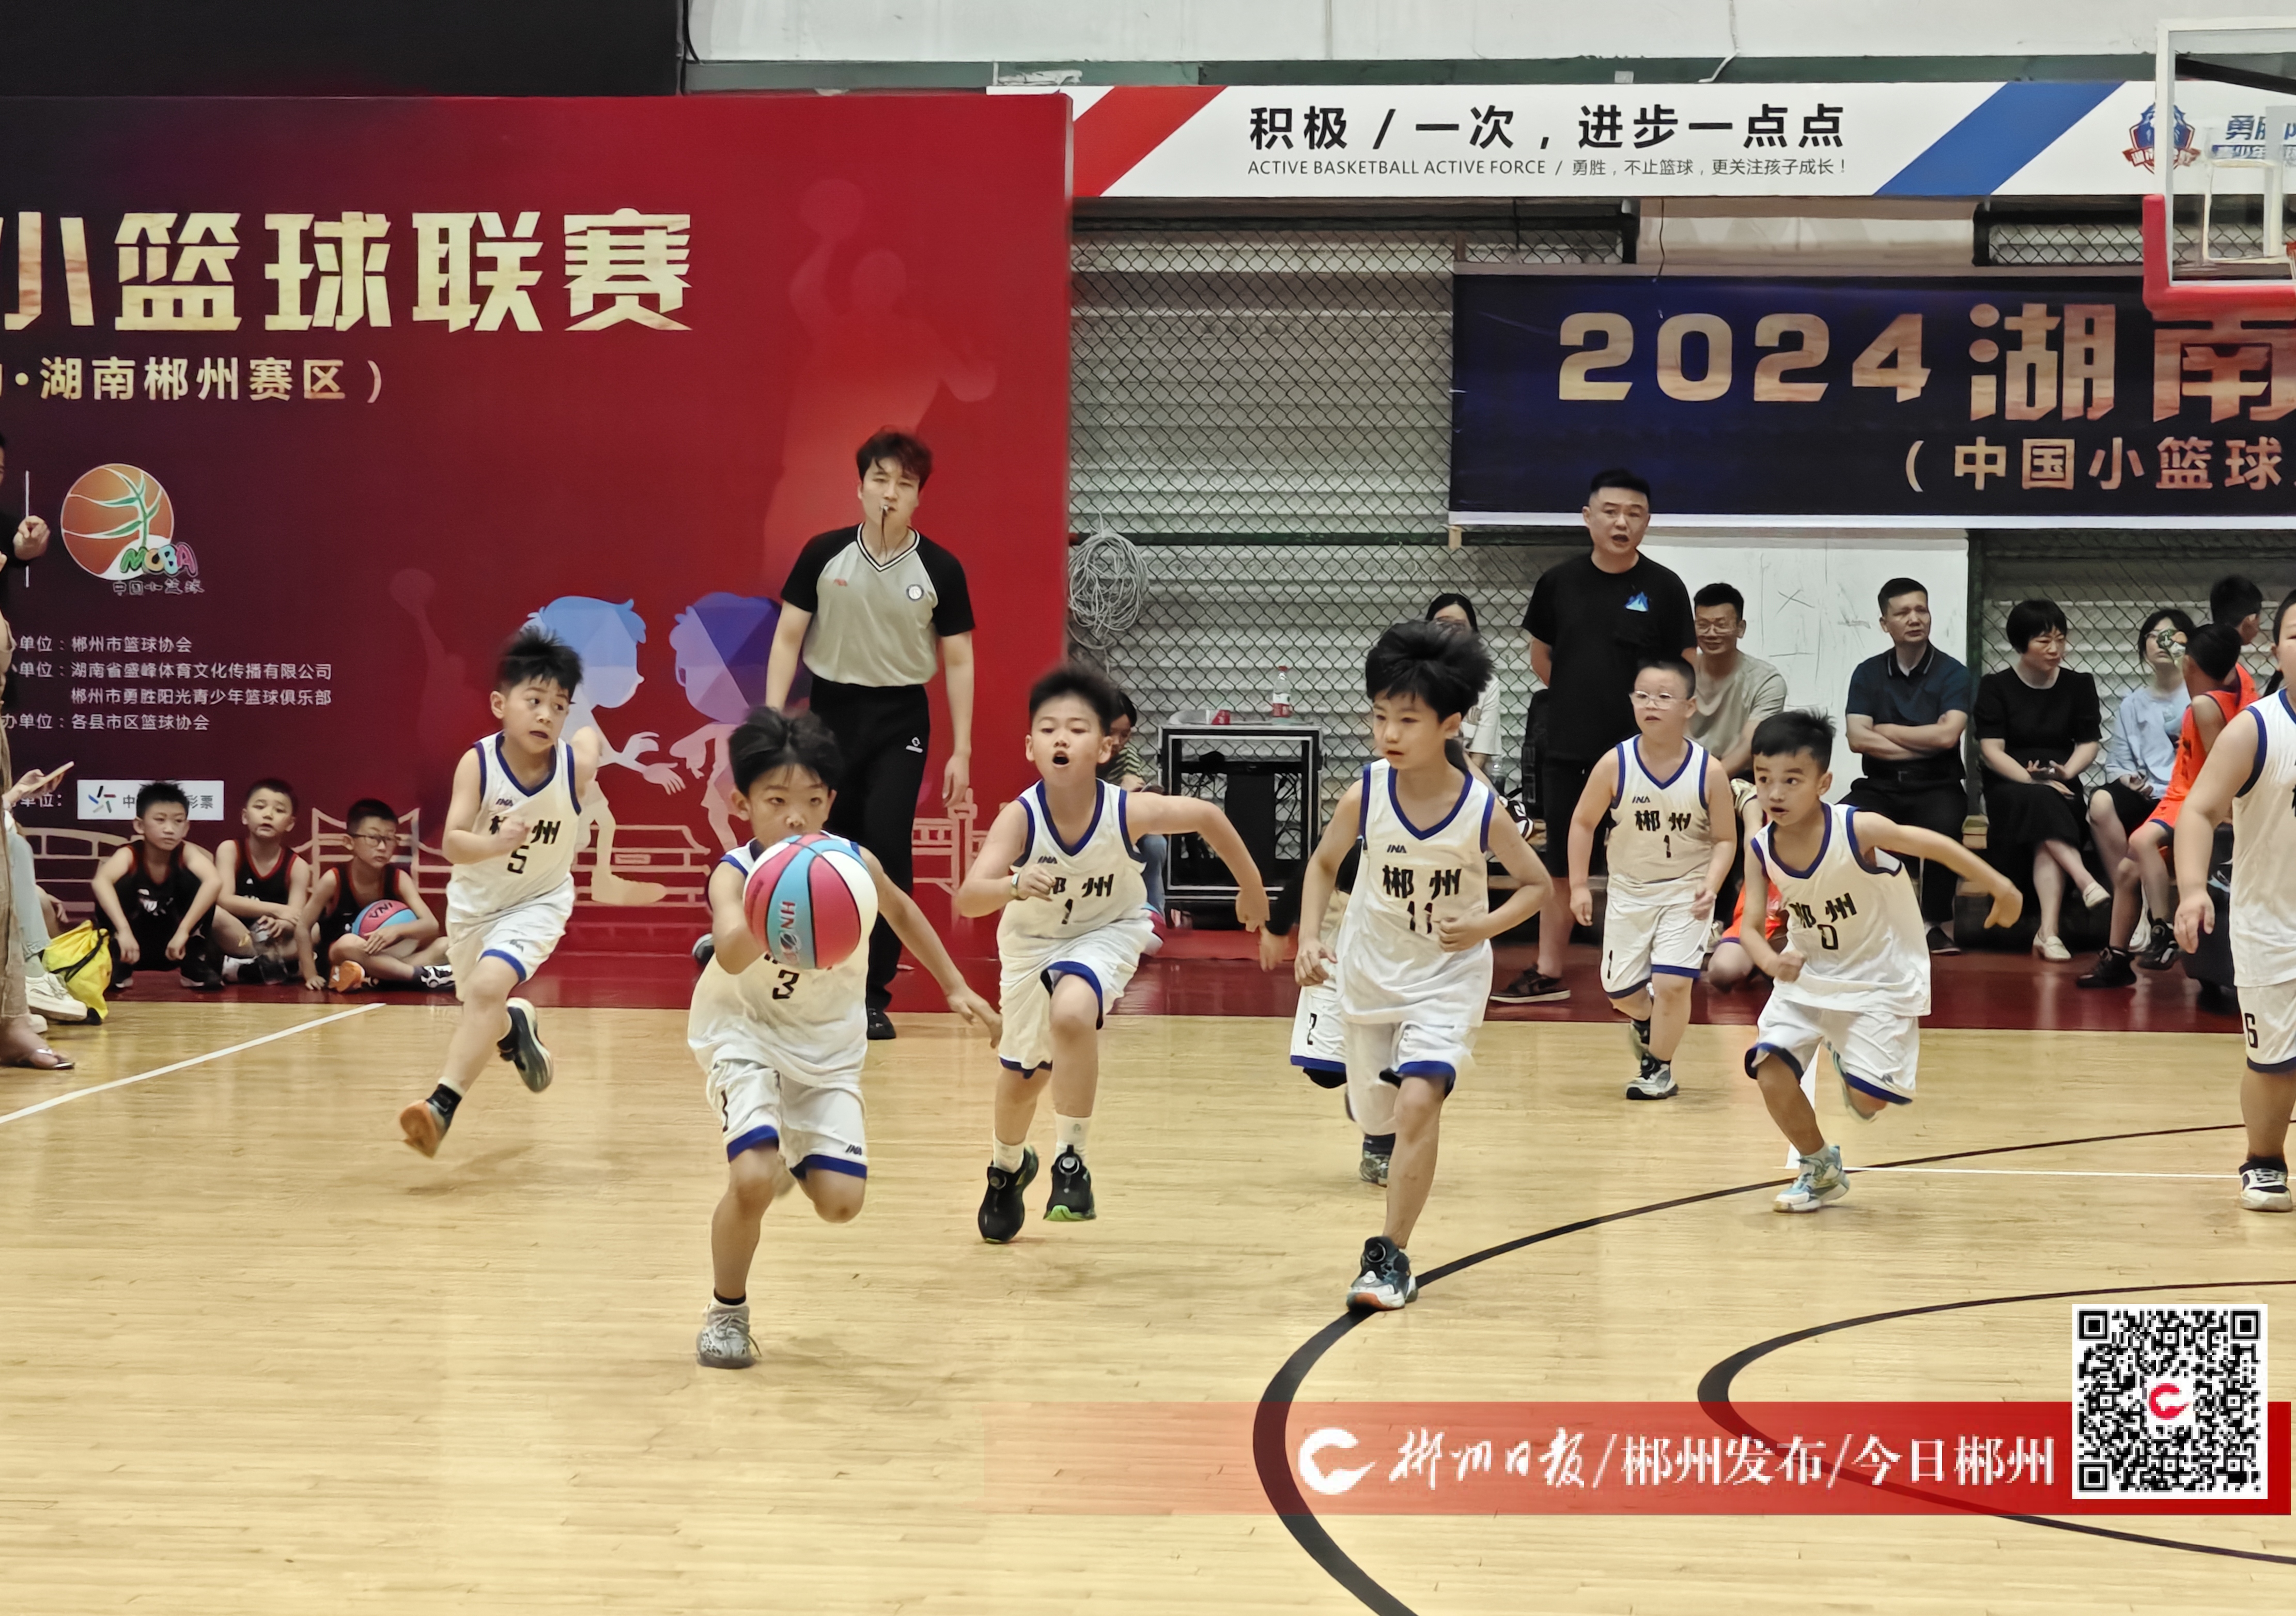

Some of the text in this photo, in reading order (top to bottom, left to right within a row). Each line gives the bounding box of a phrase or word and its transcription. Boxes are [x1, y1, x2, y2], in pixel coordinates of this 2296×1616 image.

[1250, 103, 1844, 150] 积极 / 一次，进步一点点
[1248, 158, 1846, 176] ACTIVE BASKETBALL ACTIVE FORCE / 勇胜，不止篮球，更关注孩子成长！
[0, 208, 692, 333] 小篮球联赛
[0, 356, 383, 403] ·湖南郴州赛区）
[1905, 436, 2296, 493] （中国小篮球
[11, 661, 332, 680] 单位：湖南省盛峰体育文化传播有限公司
[71, 688, 332, 705] 郴州市勇胜阳光青少年篮球俱乐部
[507, 845, 530, 874] 5
[1387, 844, 1407, 853] INA
[1663, 835, 1671, 858] 1
[1383, 865, 1462, 899] 郴州
[1061, 899, 1073, 925] 1
[1407, 900, 1433, 935] 11
[772, 970, 800, 1000] 3
[2244, 1013, 2259, 1049] 6
